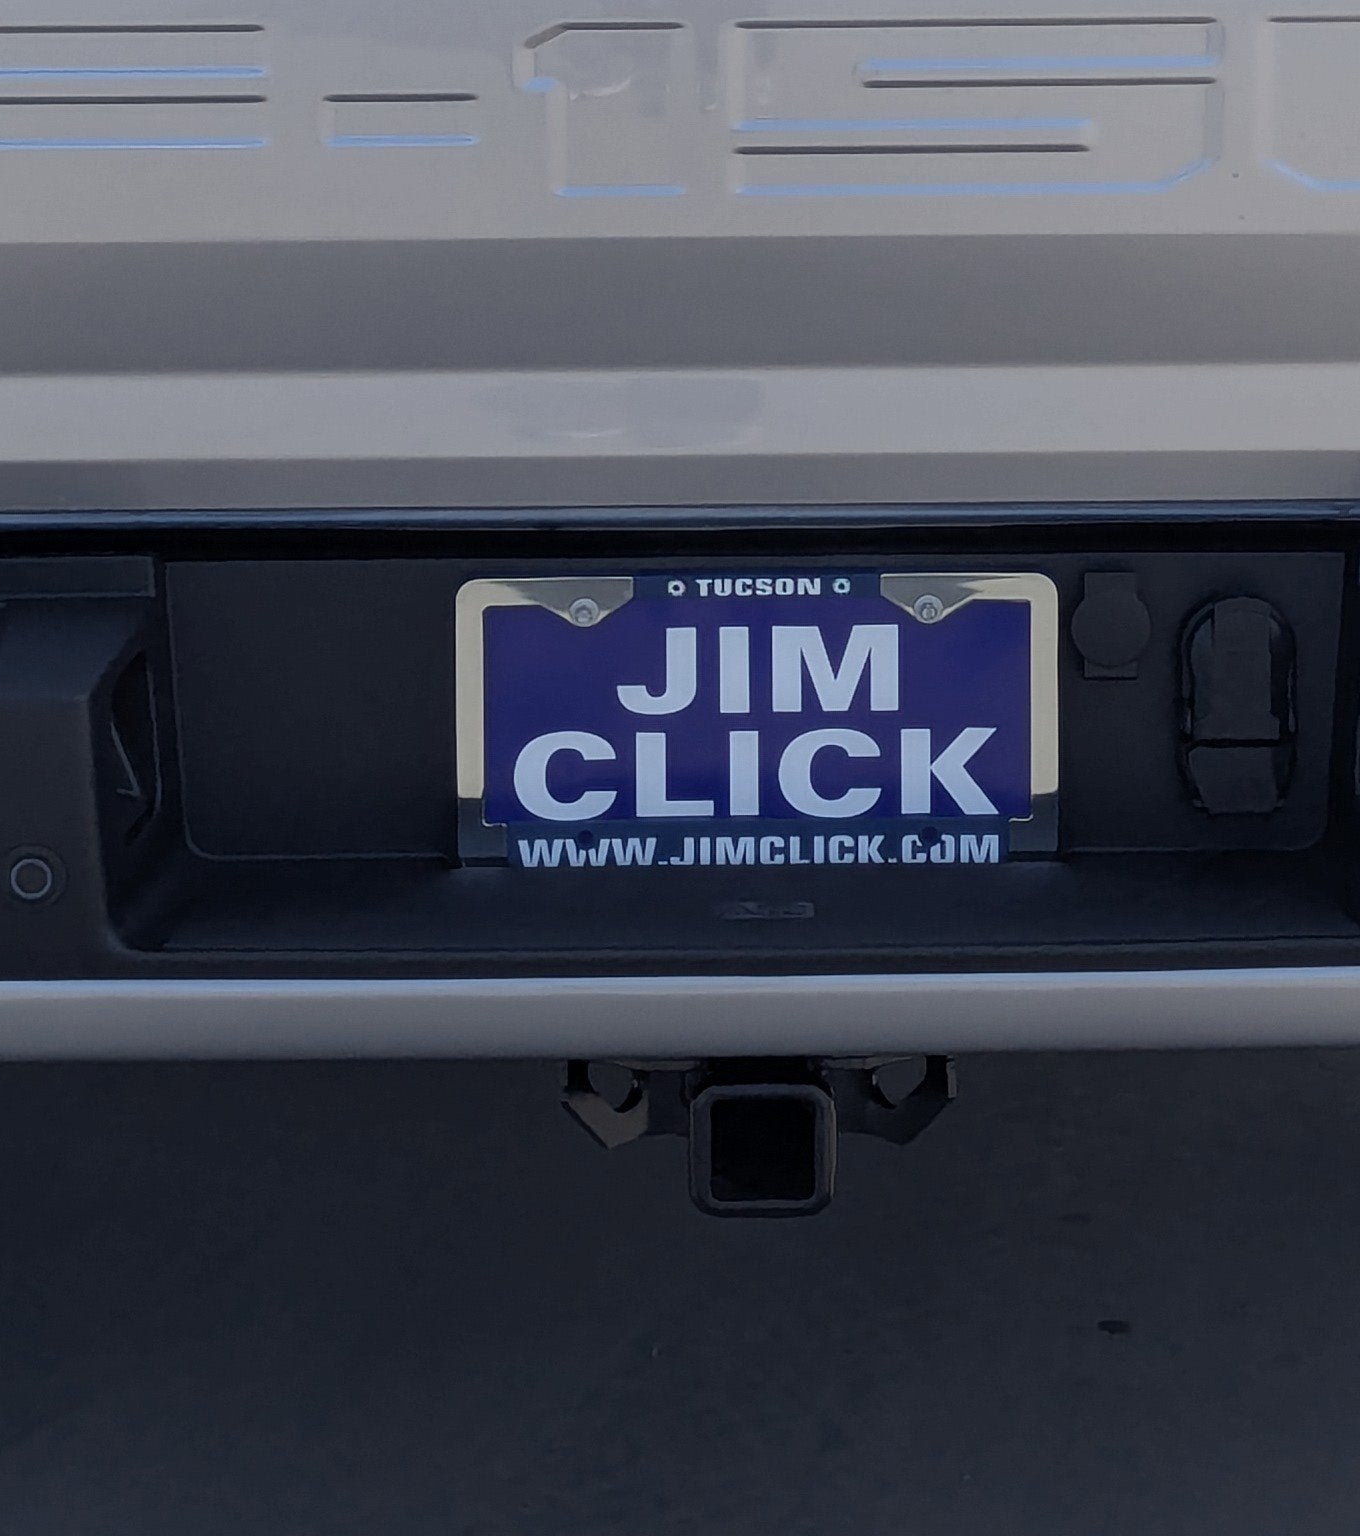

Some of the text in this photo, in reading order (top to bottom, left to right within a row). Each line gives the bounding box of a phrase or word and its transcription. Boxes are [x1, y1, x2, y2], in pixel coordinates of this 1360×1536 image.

[694, 577, 822, 597] TUCSON
[616, 624, 900, 716] JIM
[513, 727, 999, 822] CLICK
[517, 834, 1000, 868] WWW.JIMCLICK.COM
